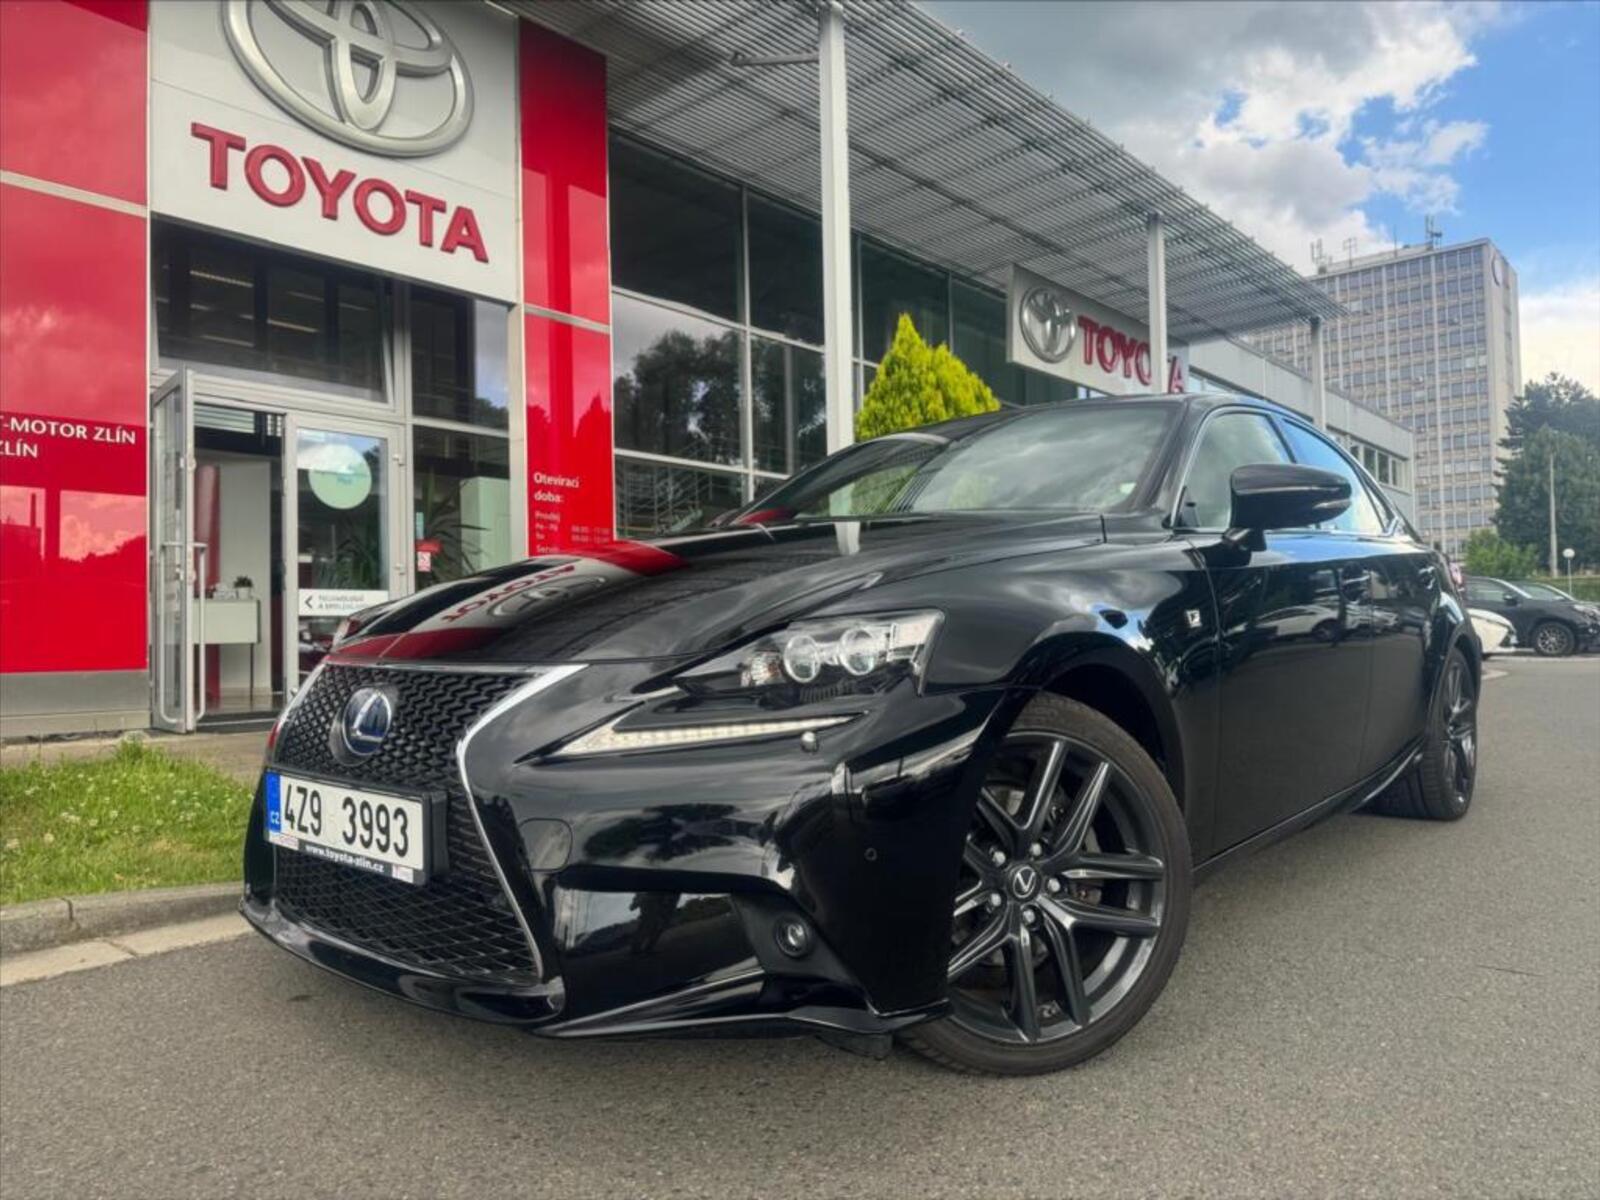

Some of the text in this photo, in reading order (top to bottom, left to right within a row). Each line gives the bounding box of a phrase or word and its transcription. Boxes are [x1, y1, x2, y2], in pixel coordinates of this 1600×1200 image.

[191, 122, 489, 263] TOYOTA
[1077, 315, 1185, 394] TOYOA
[0, 415, 136, 445] -MOTOR ZLÍN
[284, 784, 408, 858] 4Z9 3993
